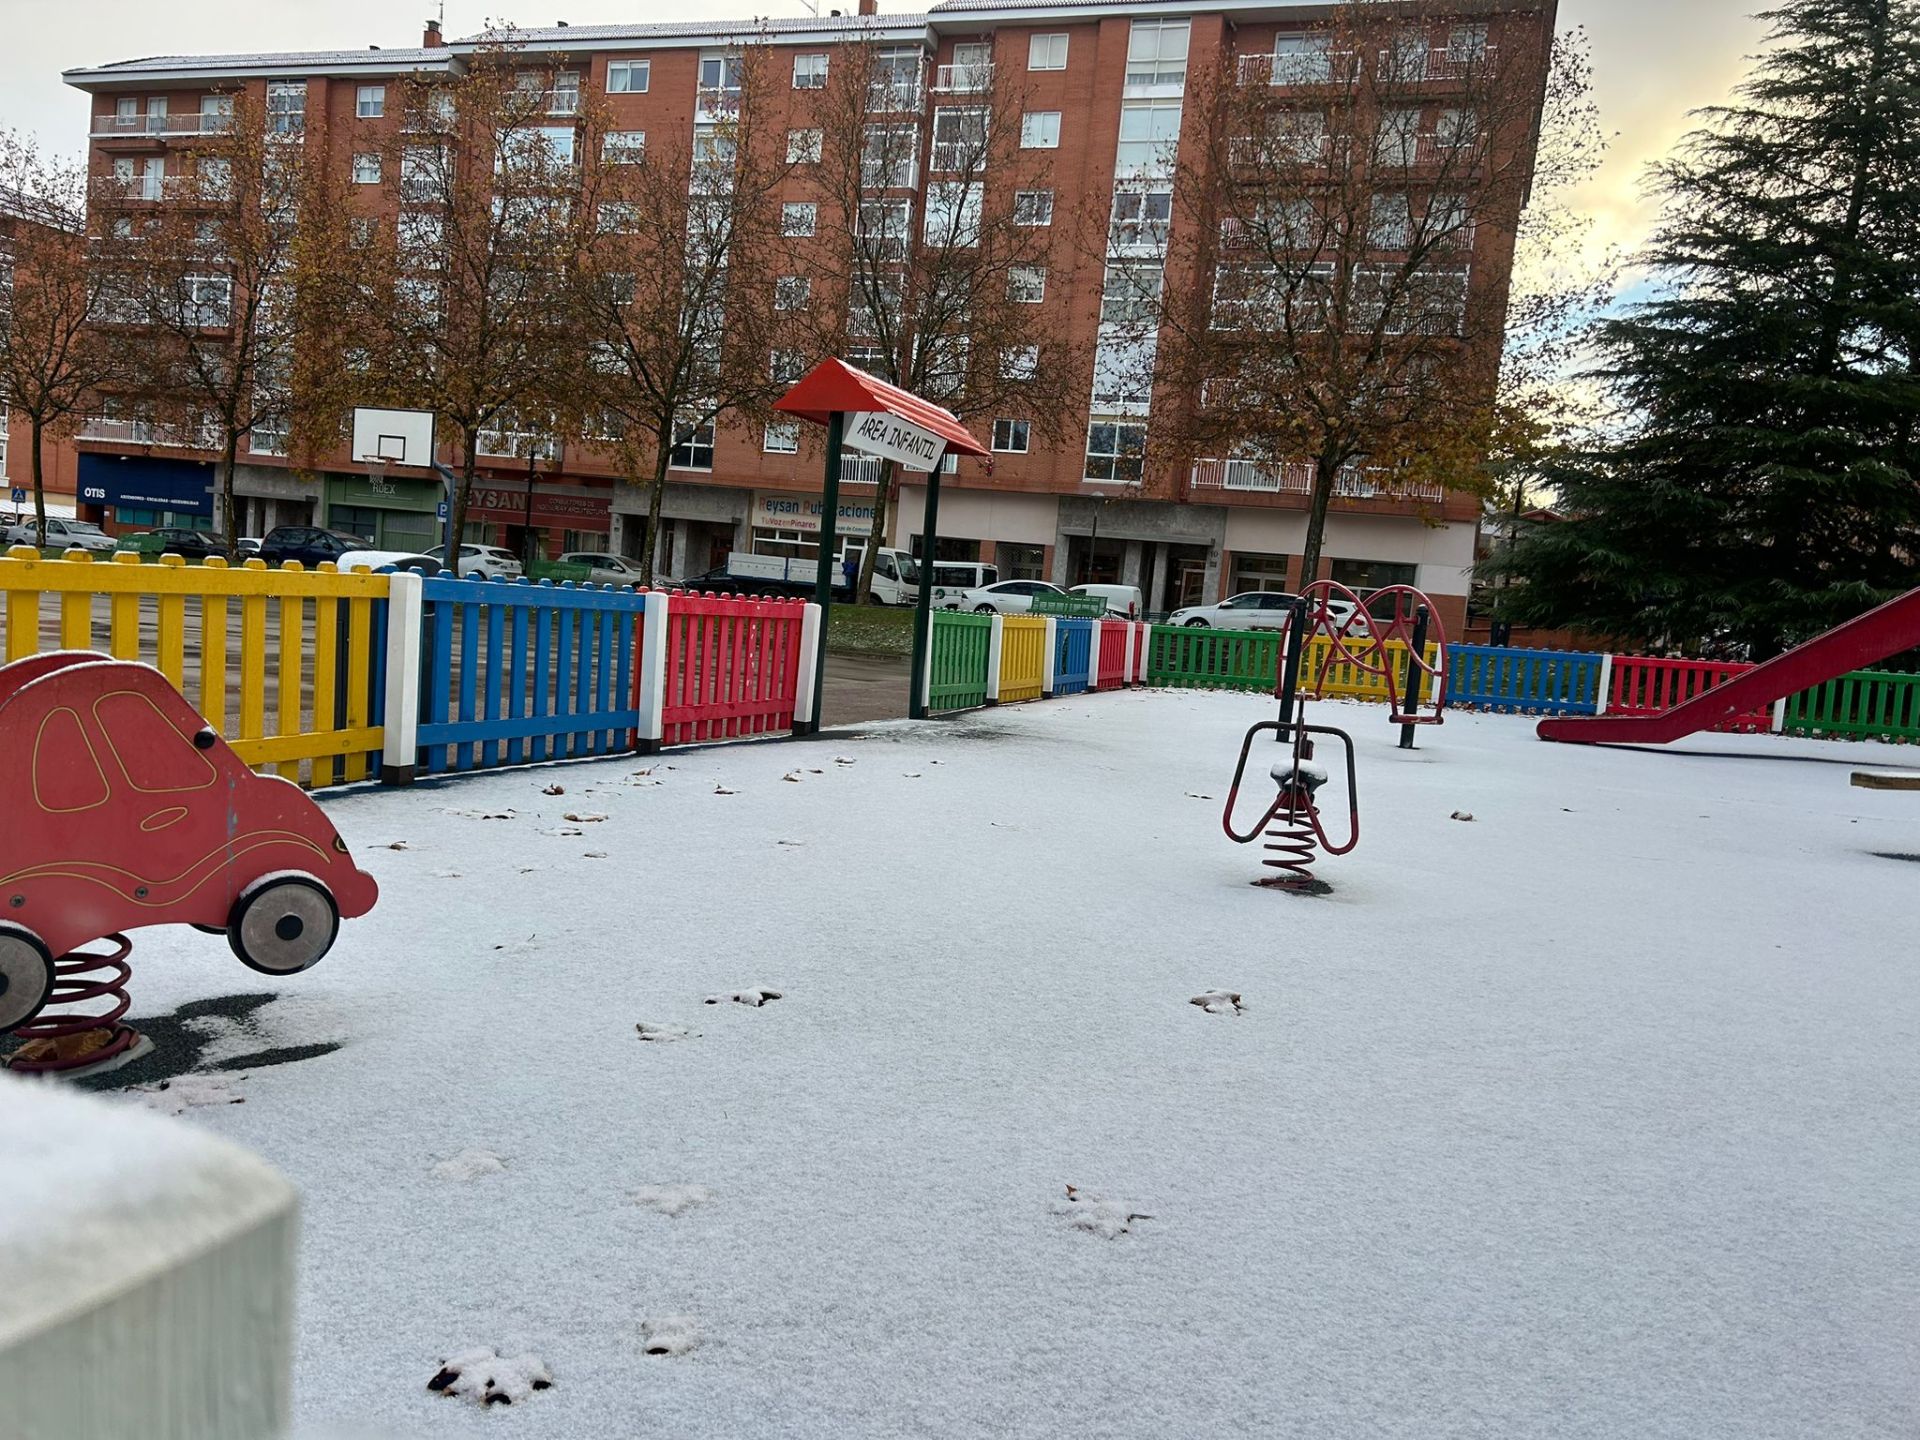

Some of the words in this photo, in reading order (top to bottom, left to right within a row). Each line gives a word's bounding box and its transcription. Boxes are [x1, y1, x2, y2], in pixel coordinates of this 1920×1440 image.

[887, 427, 937, 460] INFANTIL
[84, 487, 106, 499] OTIS
[440, 504, 448, 516] P
[759, 497, 799, 515] Reysan
[803, 500, 876, 519] Pubacione
